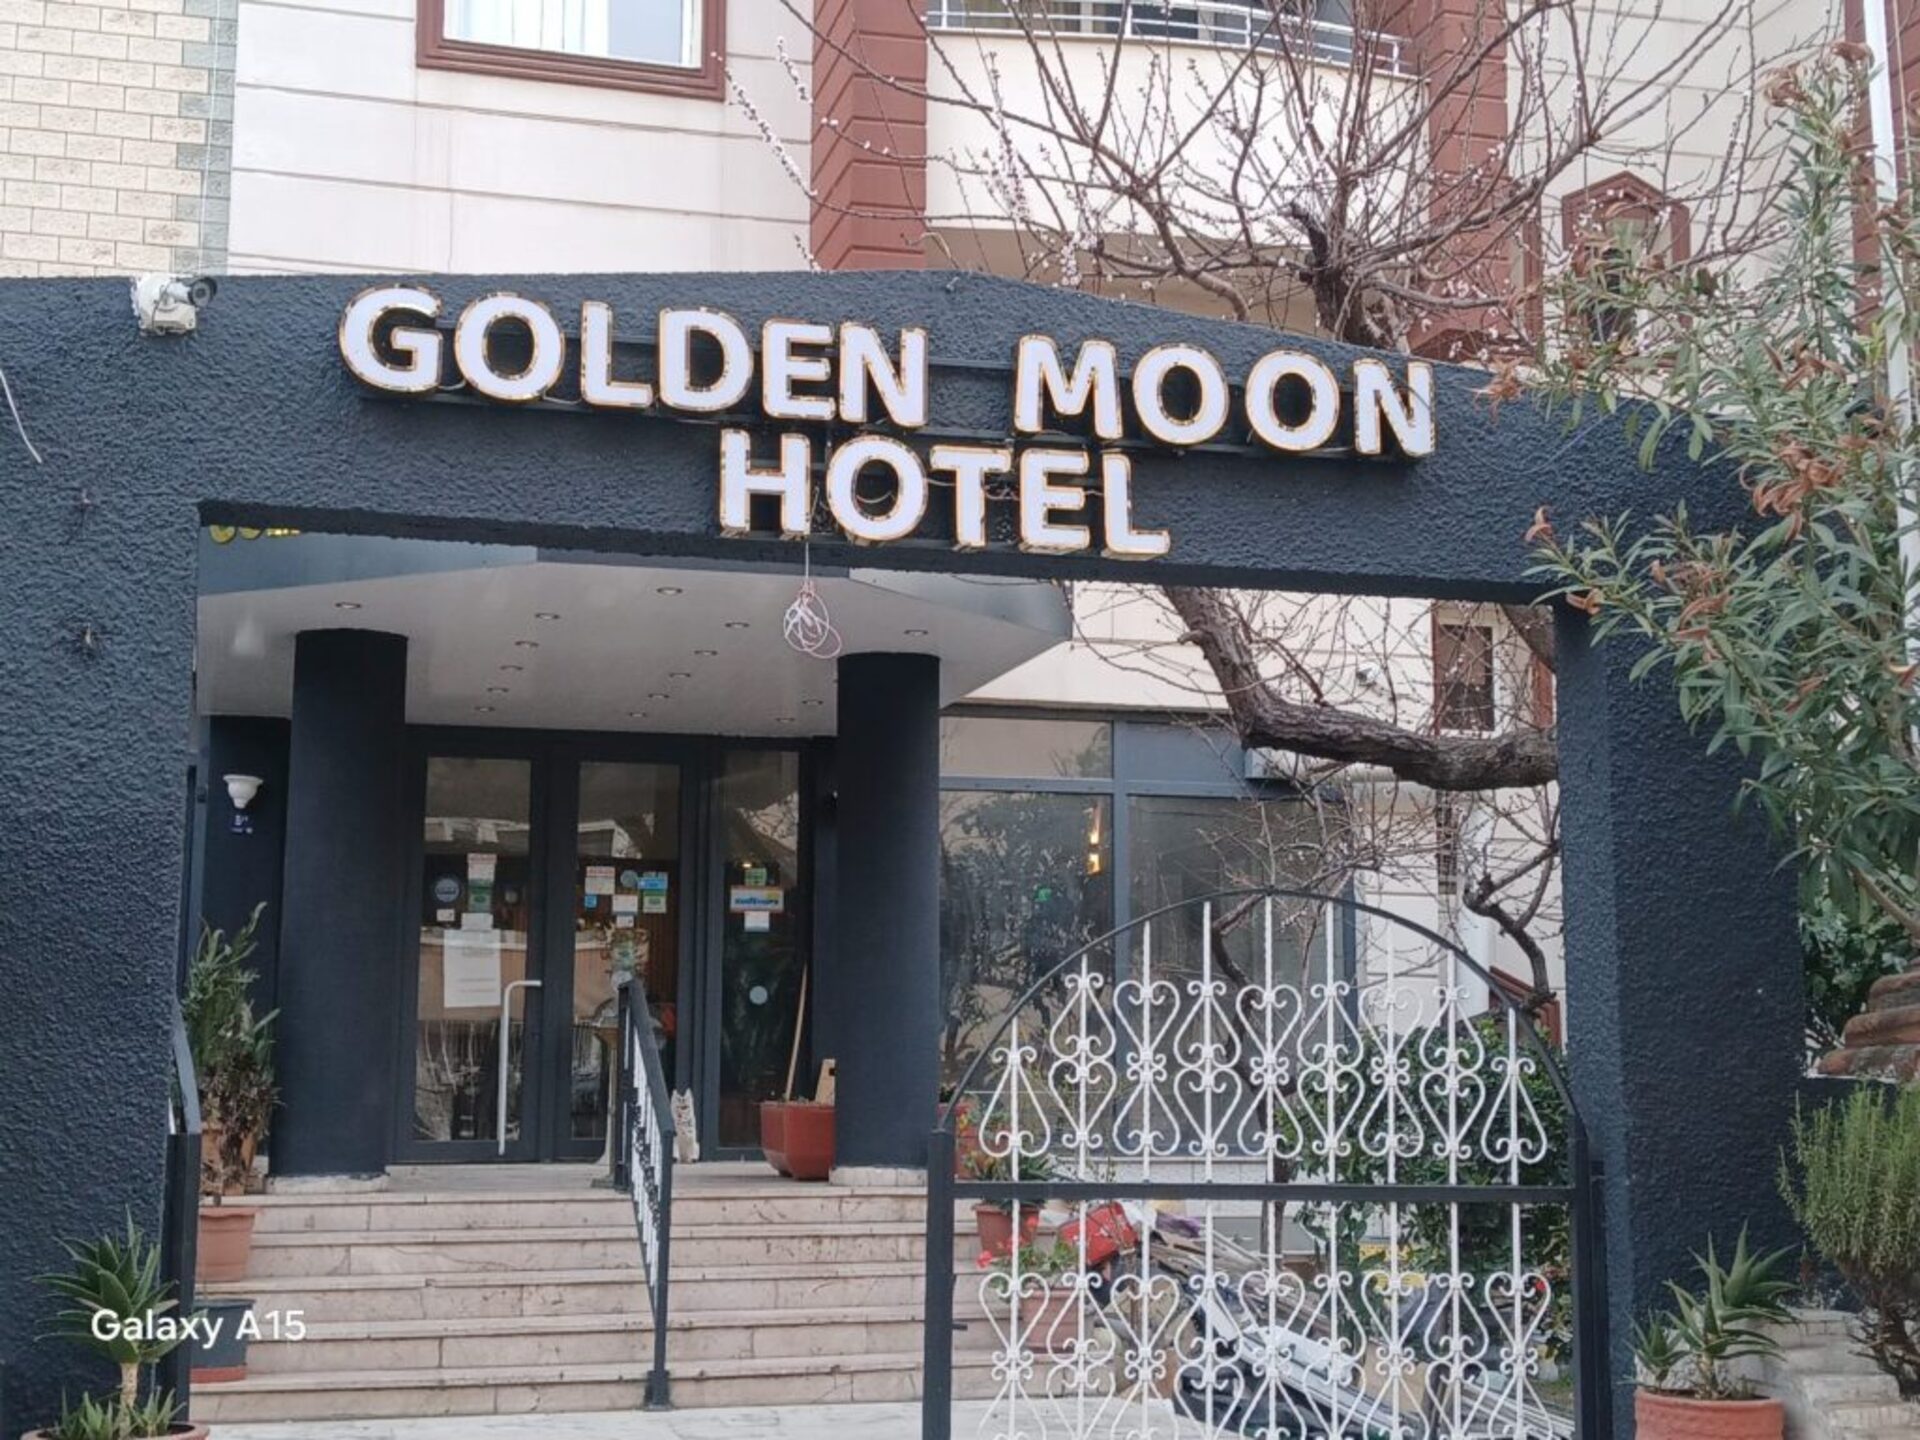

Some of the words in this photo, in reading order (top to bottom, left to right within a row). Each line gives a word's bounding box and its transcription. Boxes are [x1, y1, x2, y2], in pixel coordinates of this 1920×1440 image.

[340, 285, 928, 427] GOLDEN
[1014, 335, 1436, 457] MOON
[718, 430, 1171, 558] HOTEL
